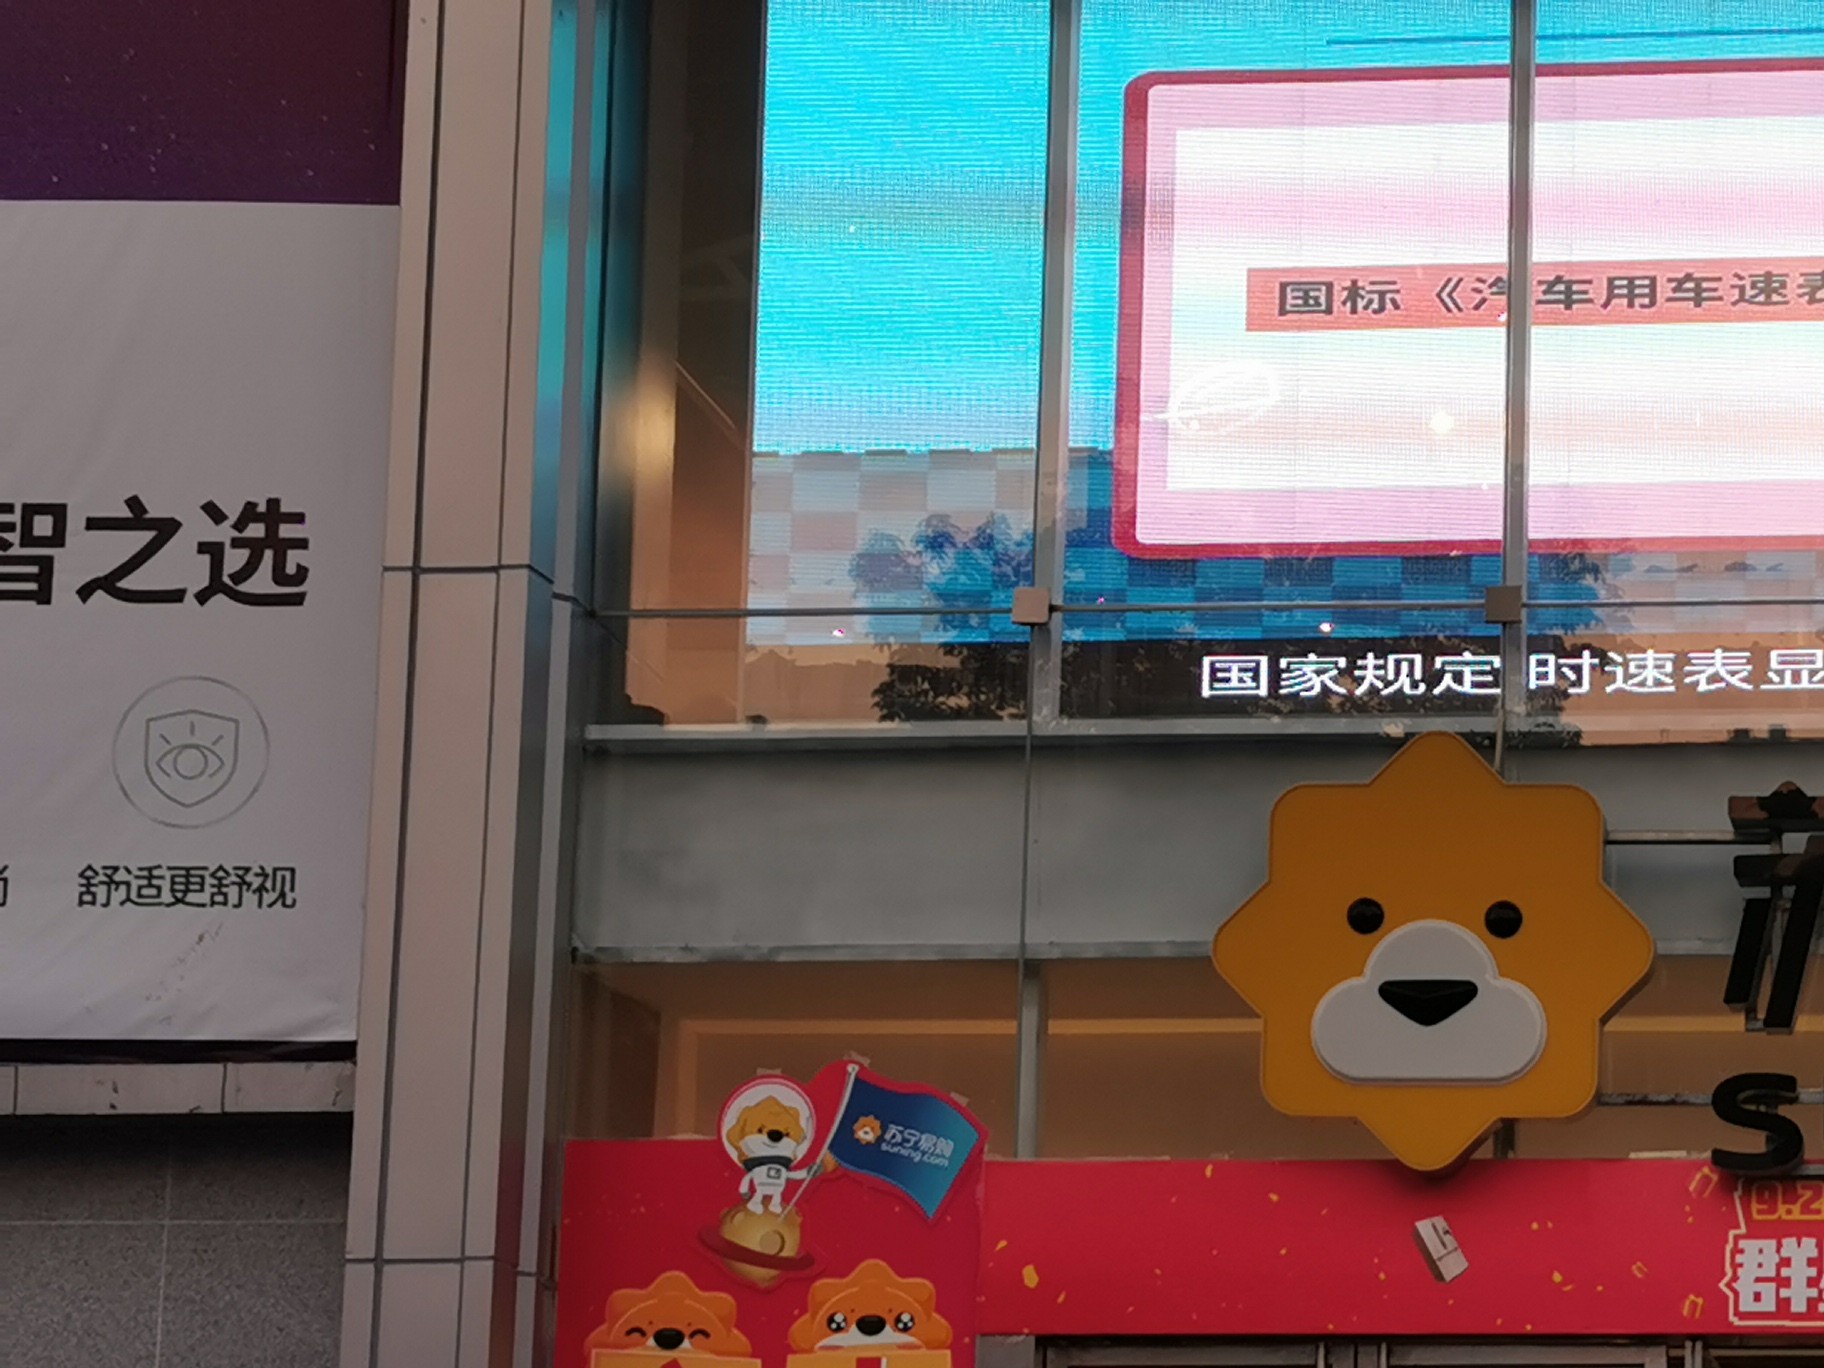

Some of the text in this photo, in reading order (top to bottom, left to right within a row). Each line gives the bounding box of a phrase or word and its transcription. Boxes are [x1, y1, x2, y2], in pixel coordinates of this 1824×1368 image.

[0, 494, 309, 607] 智之选
[77, 864, 298, 909] 舒适更舒视
